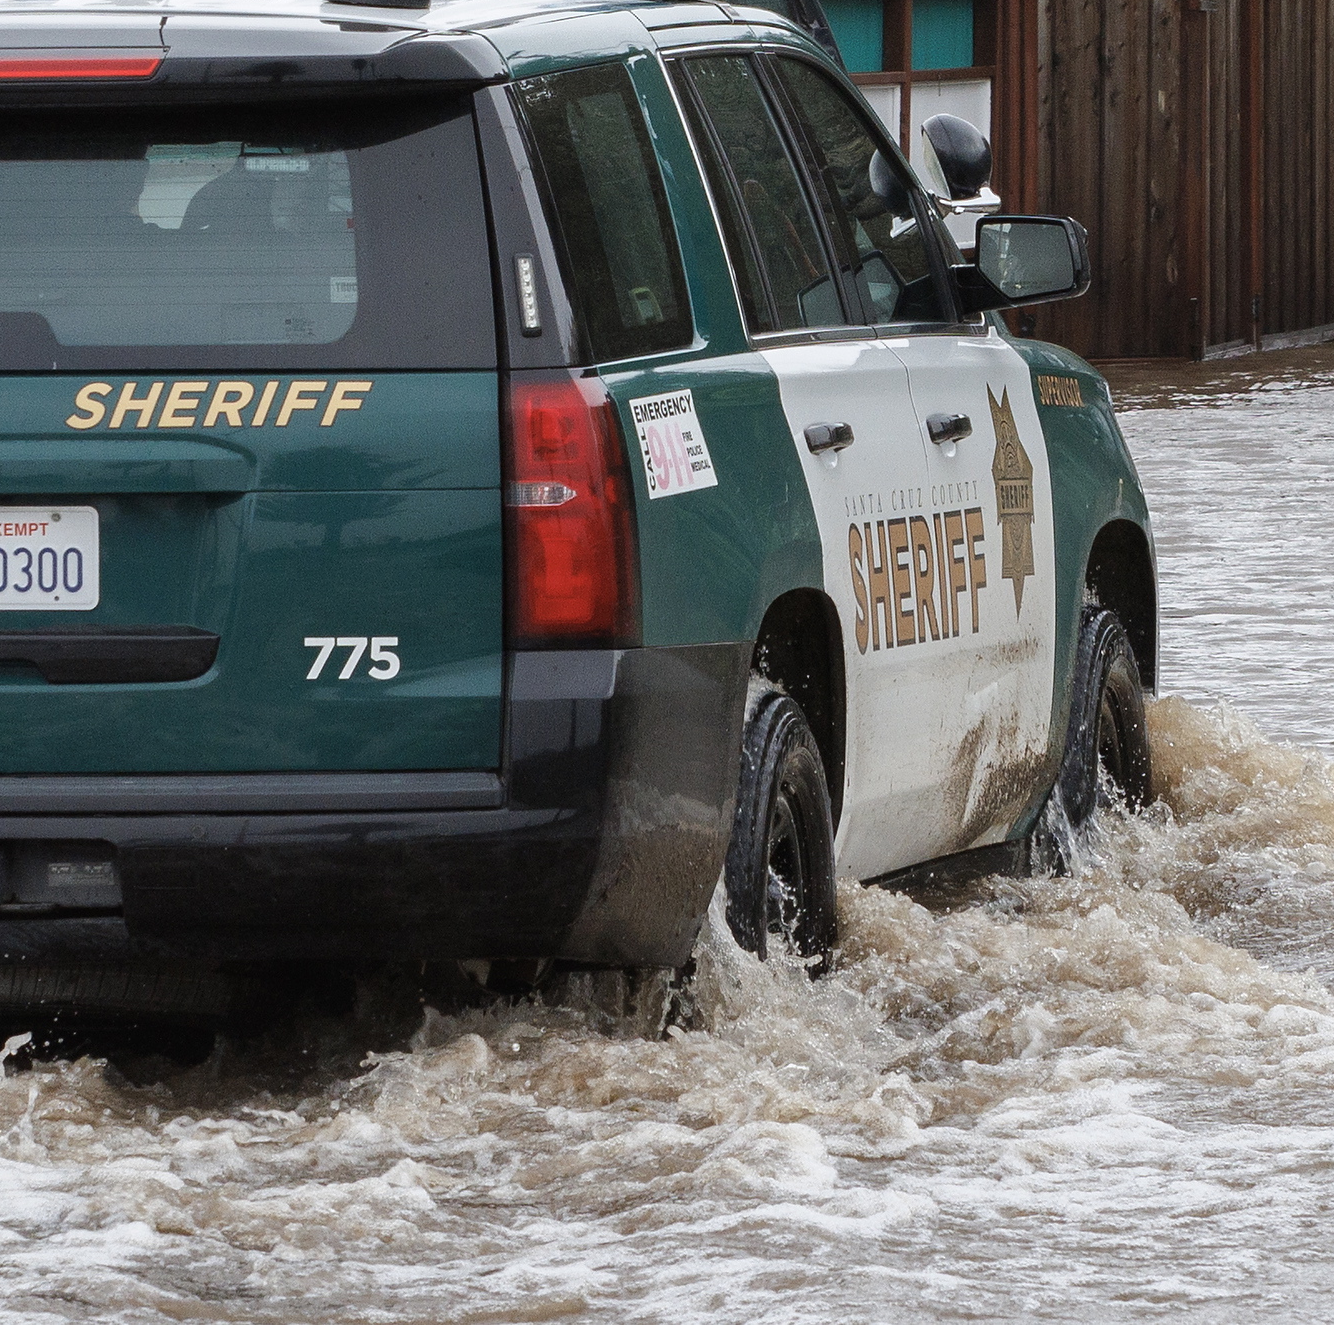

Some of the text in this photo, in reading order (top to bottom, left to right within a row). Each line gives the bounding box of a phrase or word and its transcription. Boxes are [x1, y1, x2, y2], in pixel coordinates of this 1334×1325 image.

[65, 380, 374, 430] SHERIFF
[633, 394, 692, 423] EMERGENCY
[681, 431, 694, 442] FIRE
[686, 445, 703, 458] POLICE
[641, 427, 657, 491] CALL
[690, 459, 711, 472] MEDICAL
[844, 480, 979, 518] SANTA CRUZ COUNTY
[1000, 484, 1030, 510] SHERIFF
[848, 506, 987, 656] SHERIFF
[304, 636, 401, 680] 775
